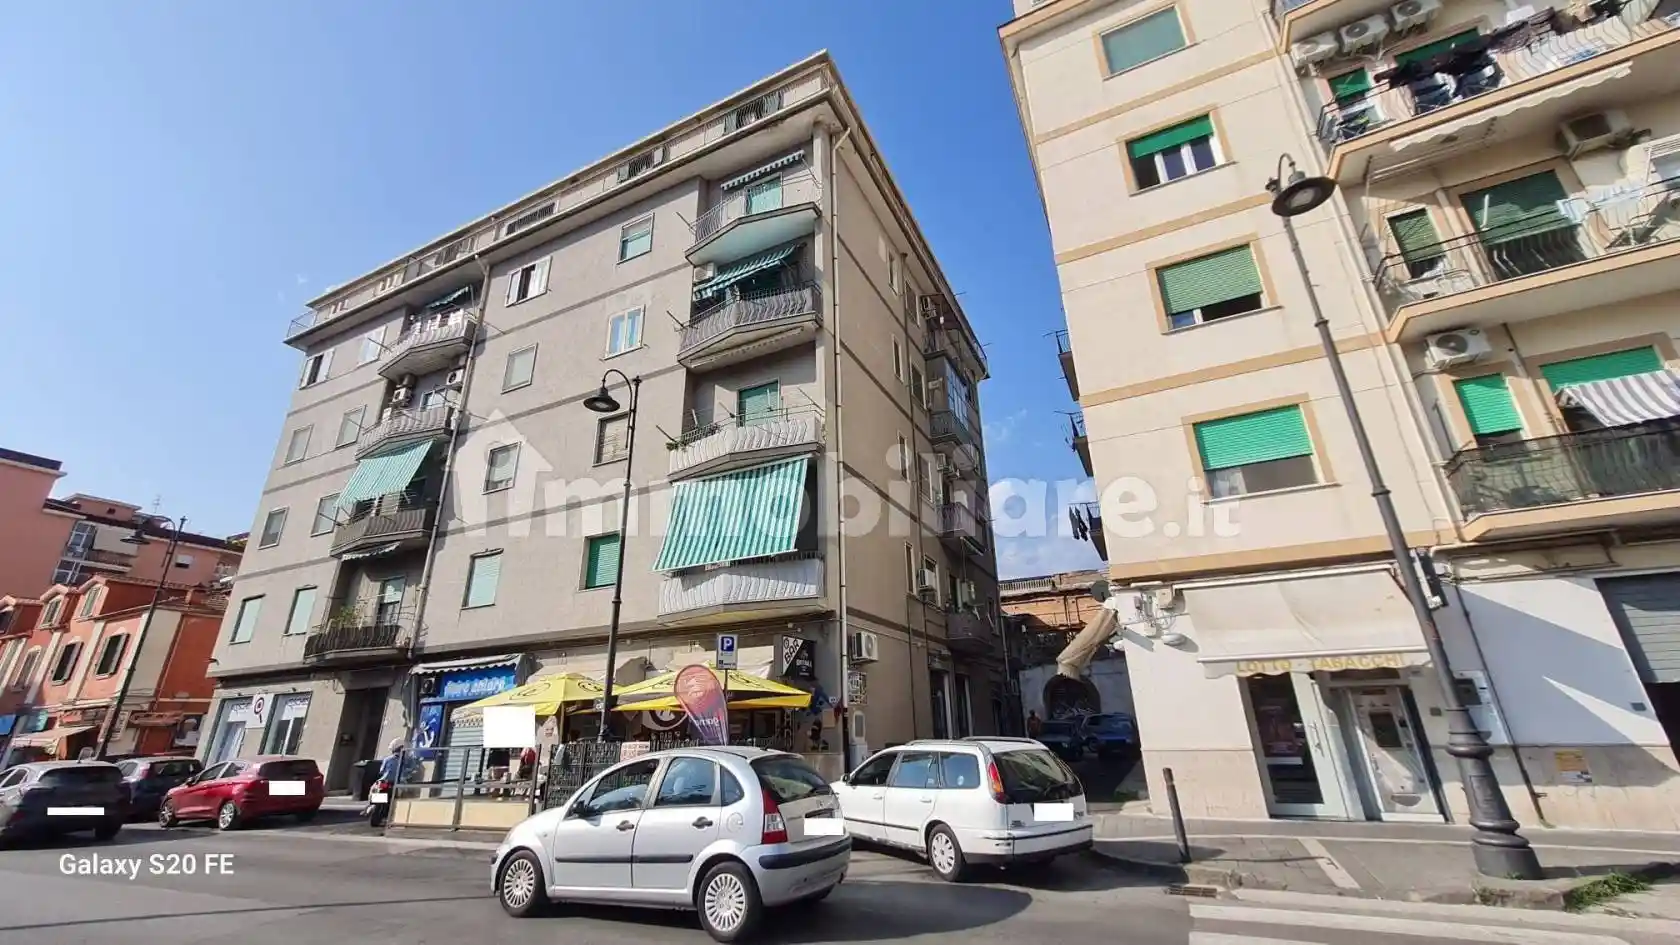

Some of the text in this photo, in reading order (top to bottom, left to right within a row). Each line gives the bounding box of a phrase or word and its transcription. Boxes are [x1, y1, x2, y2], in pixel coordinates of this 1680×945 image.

[723, 637, 733, 650] P
[784, 638, 800, 665] BAR
[1236, 653, 1405, 674] LOTTO TABACCHI
